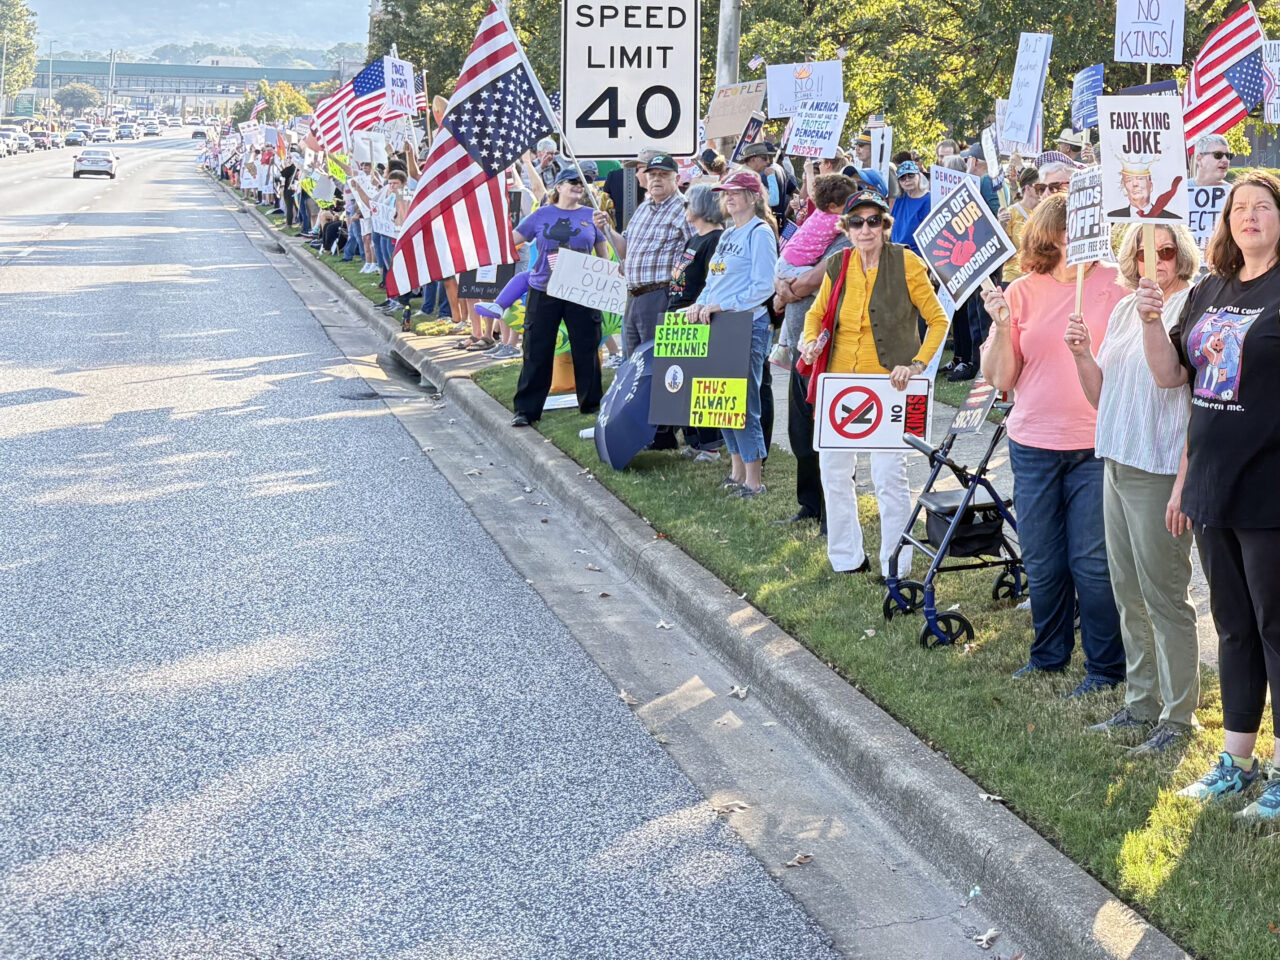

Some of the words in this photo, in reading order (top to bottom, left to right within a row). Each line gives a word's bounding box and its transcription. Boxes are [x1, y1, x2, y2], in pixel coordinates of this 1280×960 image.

[575, 4, 687, 29] SPEED
[1120, 19, 1175, 58] KINGS!
[587, 45, 674, 69] LIMIT
[717, 82, 763, 99] PEOPLE
[575, 85, 681, 140] 40
[801, 101, 808, 110] IN
[809, 101, 839, 113] AMERICA
[801, 119, 830, 131] PROTECT
[1110, 111, 1170, 131] FAUX-KING
[795, 127, 833, 141] DEMOCRACY
[1122, 131, 1162, 155] JOKE
[791, 144, 823, 157] PRESIDENT
[935, 170, 963, 185] DEMOCR
[1070, 186, 1102, 211] HANDS
[919, 208, 953, 248] HANDS
[949, 188, 971, 214] OFF
[951, 201, 983, 236] OUR
[1068, 206, 1101, 241] OFF!
[946, 235, 1001, 295] DEMOCRACY
[581, 273, 621, 295] OUR
[556, 283, 625, 314] NEIGHBO
[1206, 305, 1218, 313] As
[666, 314, 688, 326] SIC
[658, 327, 699, 341] SEMPER
[656, 342, 707, 356] TYRANNIS
[696, 381, 727, 395] THUS
[694, 396, 737, 411] ALWAYS
[1226, 404, 1245, 412] me.
[692, 411, 704, 425] TO
[708, 411, 746, 427] TYRANTS
[891, 404, 903, 423] NO
[907, 395, 926, 438] KINGS
